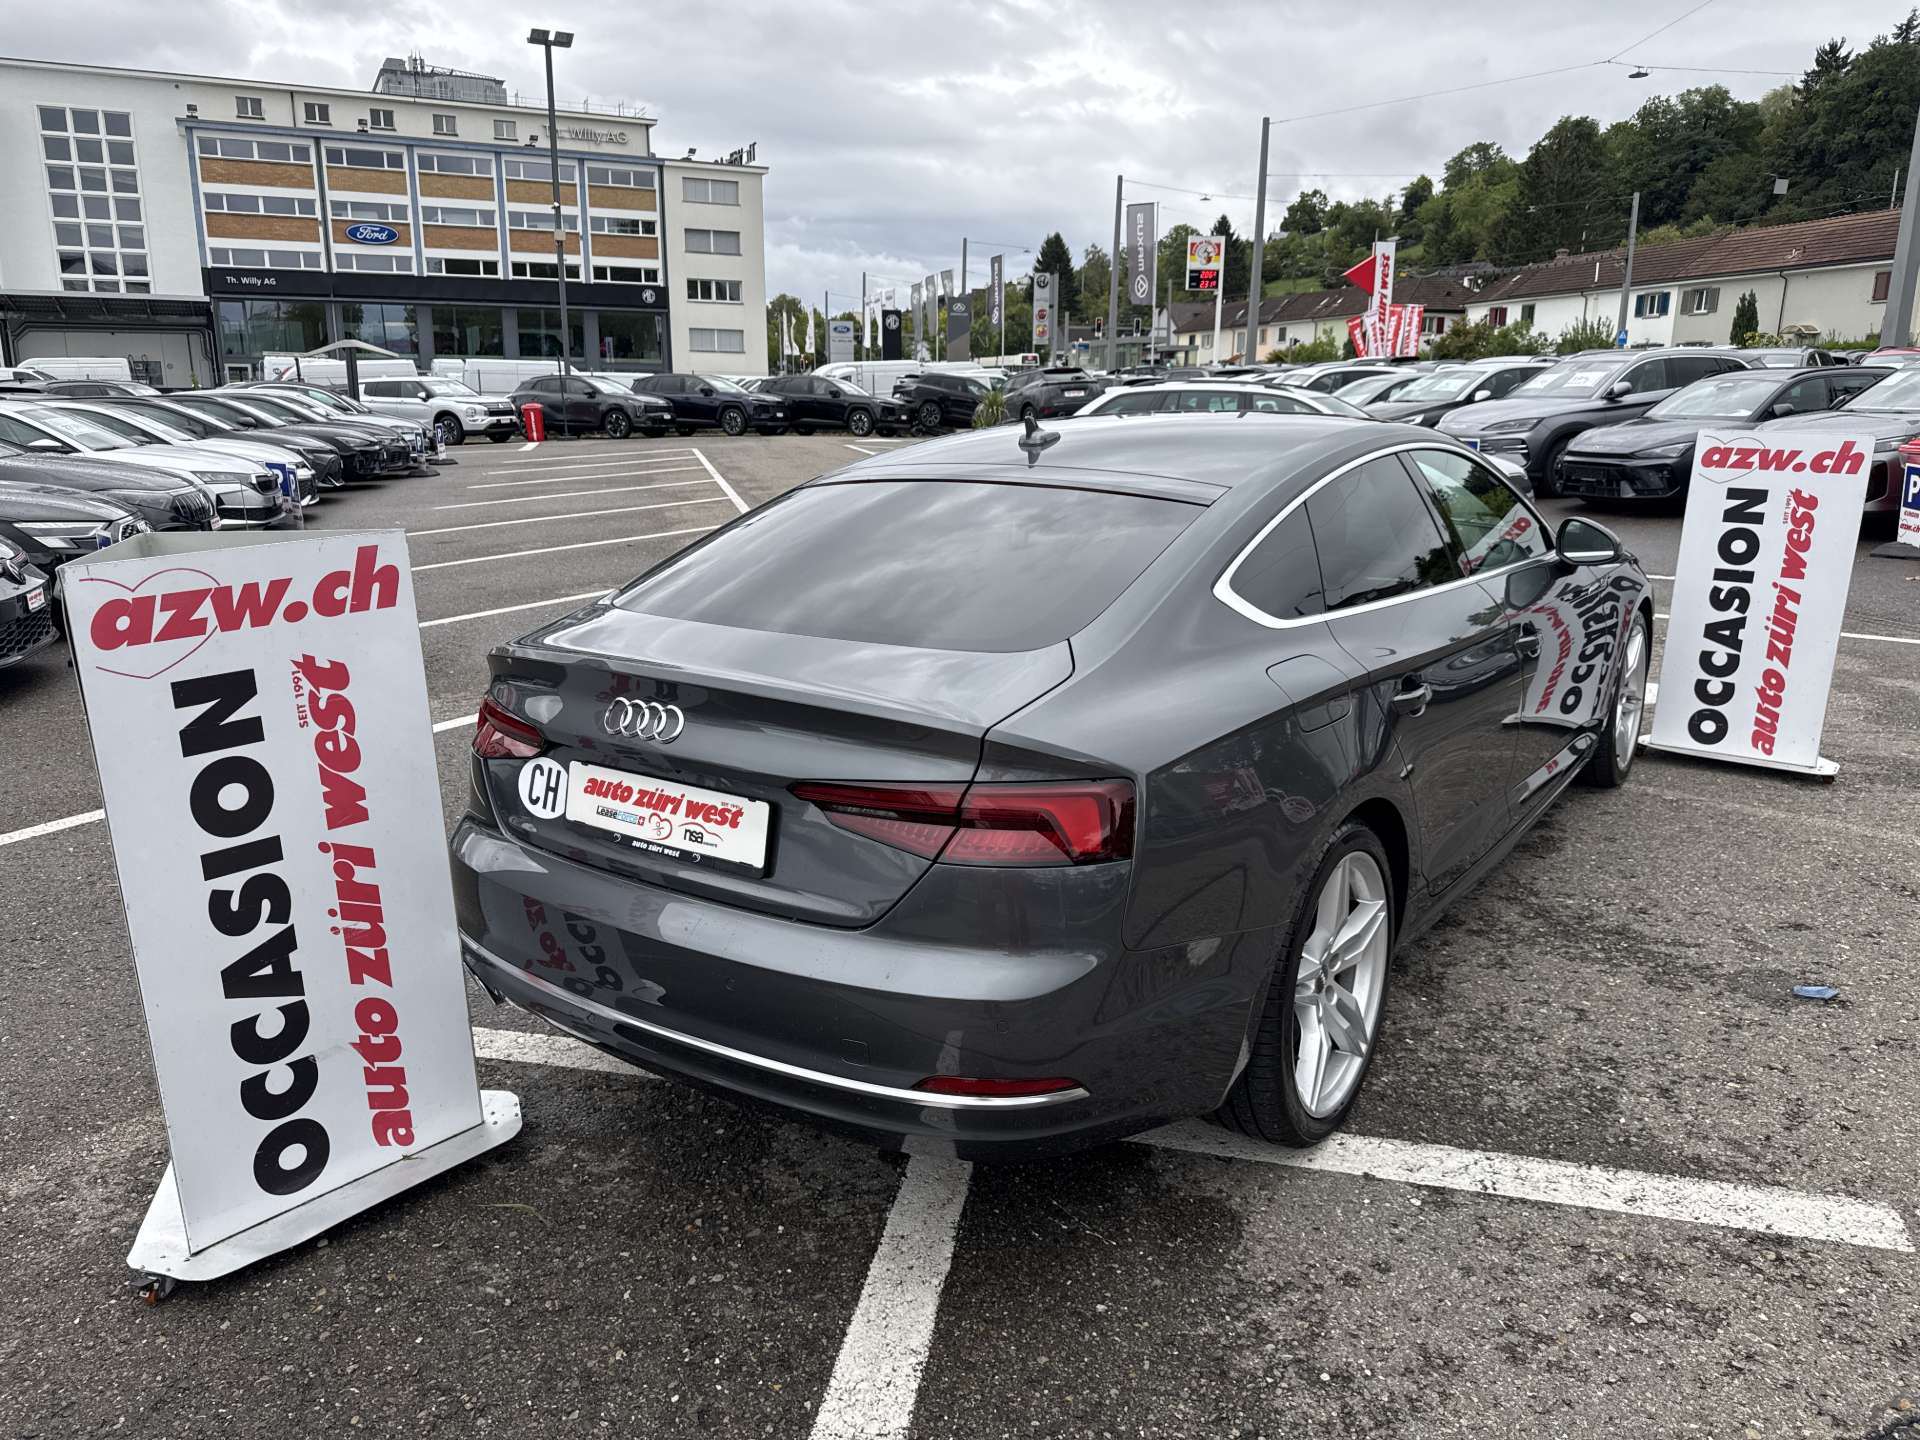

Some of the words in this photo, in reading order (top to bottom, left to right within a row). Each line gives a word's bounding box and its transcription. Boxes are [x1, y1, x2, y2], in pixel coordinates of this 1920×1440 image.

[569, 126, 602, 145] Willy
[606, 128, 630, 144] AG
[356, 225, 389, 241] Ford
[226, 276, 239, 285] Th.
[241, 277, 262, 287] Willy
[263, 278, 277, 286] AG
[1701, 441, 1865, 475] azw.ch
[1908, 474, 1920, 503] P
[1780, 488, 1819, 580] west
[91, 545, 400, 651] azw.ch
[1688, 487, 1769, 745] OCCASION
[1764, 581, 1802, 669] züri
[291, 670, 305, 699] 1991
[296, 703, 309, 729] SEIT
[1751, 668, 1786, 756] auto
[289, 653, 370, 830] west
[528, 763, 562, 813] CH
[583, 775, 635, 804] auto
[632, 787, 686, 816] züri
[685, 800, 744, 829] west
[631, 840, 647, 850] auto
[648, 842, 664, 854] züri
[664, 847, 680, 858] west
[684, 829, 704, 844] nsa
[170, 668, 331, 1196] OCCASION
[317, 841, 393, 988] züri
[349, 997, 415, 1147] auto
